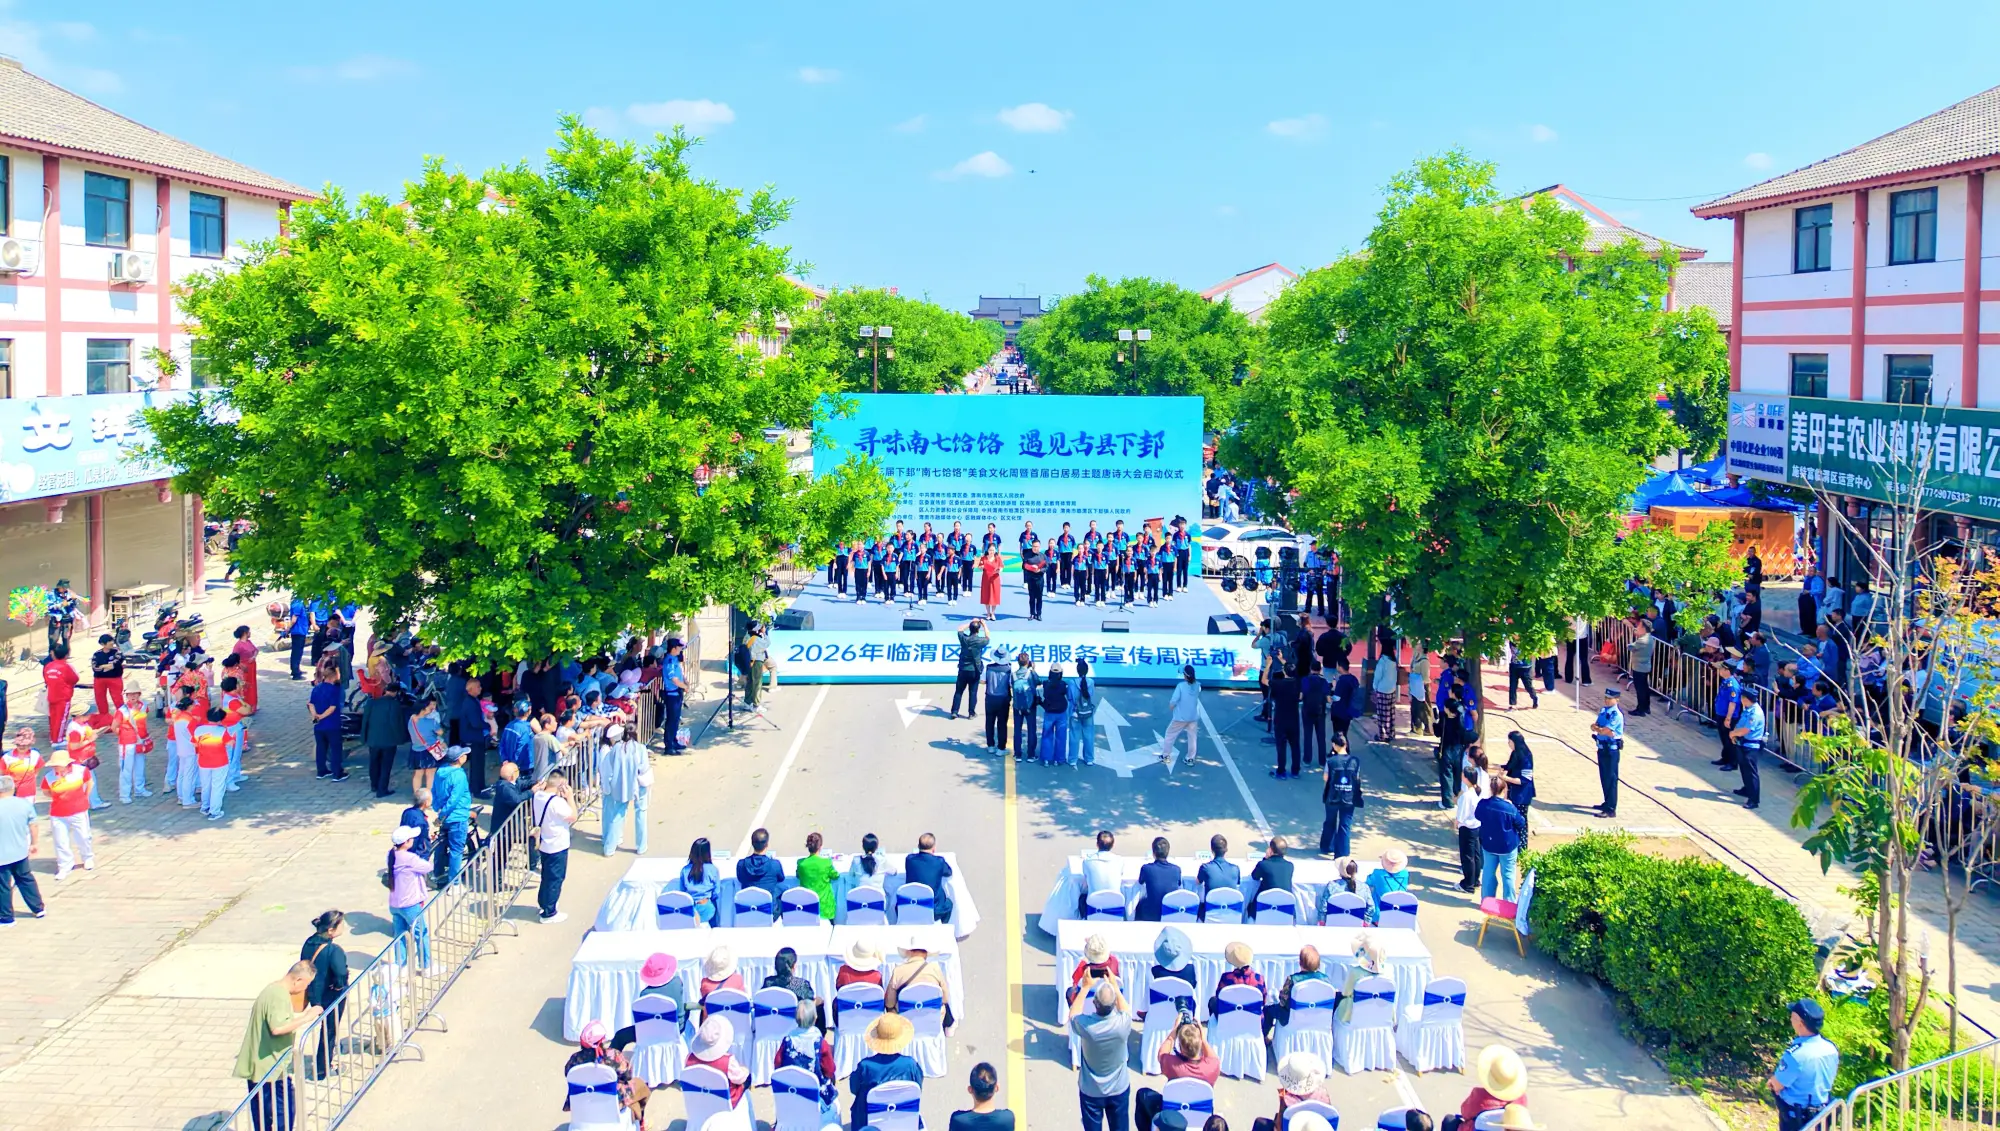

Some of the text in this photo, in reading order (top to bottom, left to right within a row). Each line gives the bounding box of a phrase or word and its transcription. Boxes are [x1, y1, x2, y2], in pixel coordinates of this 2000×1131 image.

[854, 426, 1005, 457] 寻味南七饸饹
